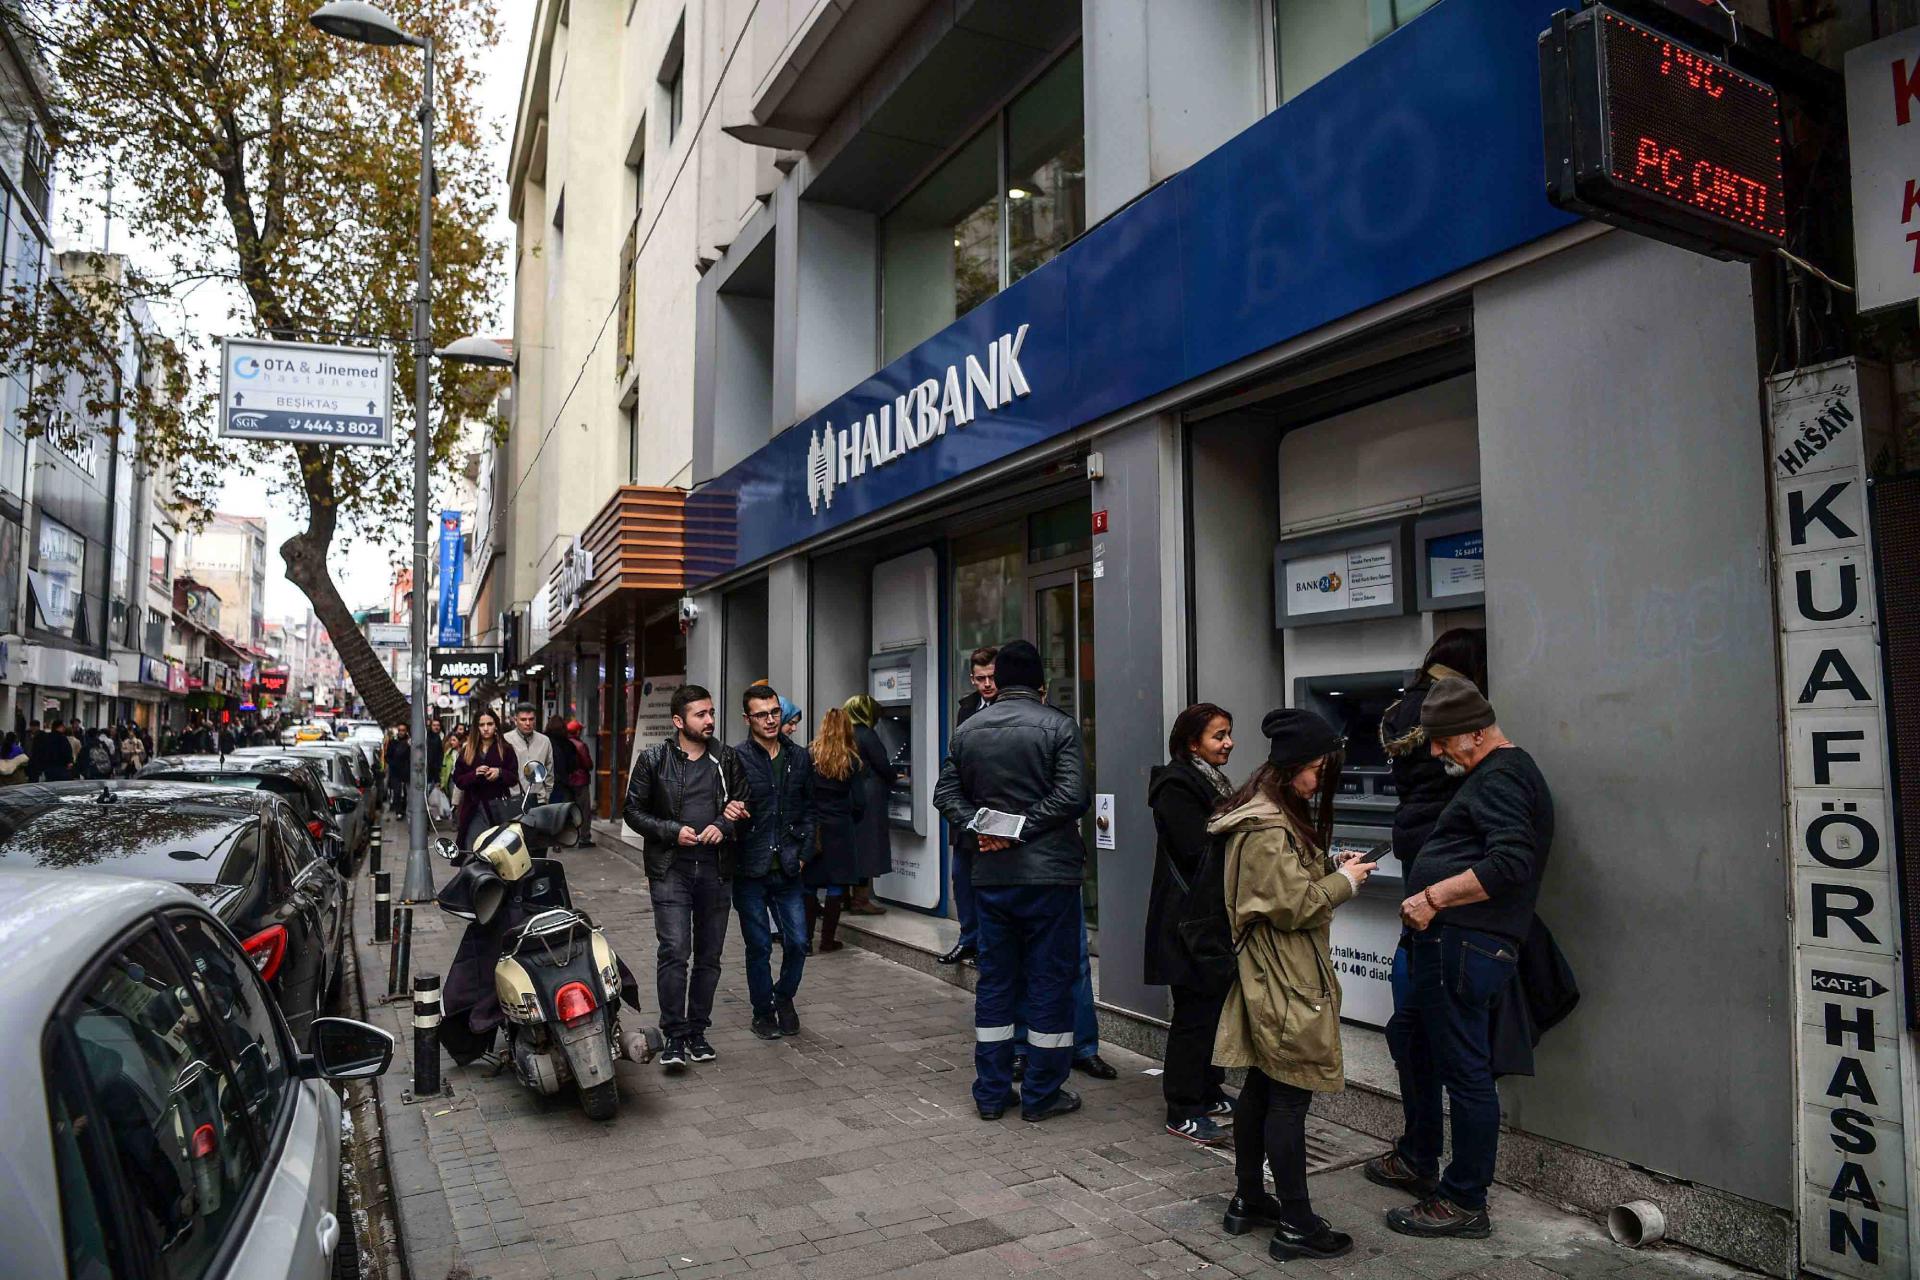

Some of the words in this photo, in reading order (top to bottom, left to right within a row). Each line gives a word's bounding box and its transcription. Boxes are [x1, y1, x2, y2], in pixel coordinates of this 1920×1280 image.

[1636, 137, 1684, 188] PC
[264, 358, 295, 373] OTA
[300, 361, 310, 374] &
[315, 362, 378, 379] Jinemed
[263, 372, 378, 389] hastanesi
[276, 395, 339, 411] BEŞİKTAŞ
[838, 323, 1031, 485] HALKBANK
[236, 416, 259, 429] SGK
[303, 418, 334, 434] 444
[336, 420, 345, 434] 3
[348, 421, 378, 436] 802
[1777, 397, 1855, 476] HASAN
[1296, 580, 1319, 593] BANK
[1787, 480, 1883, 946] KUAFÖR
[1349, 963, 1367, 978] 400
[1824, 1002, 1881, 1266] HASAN
